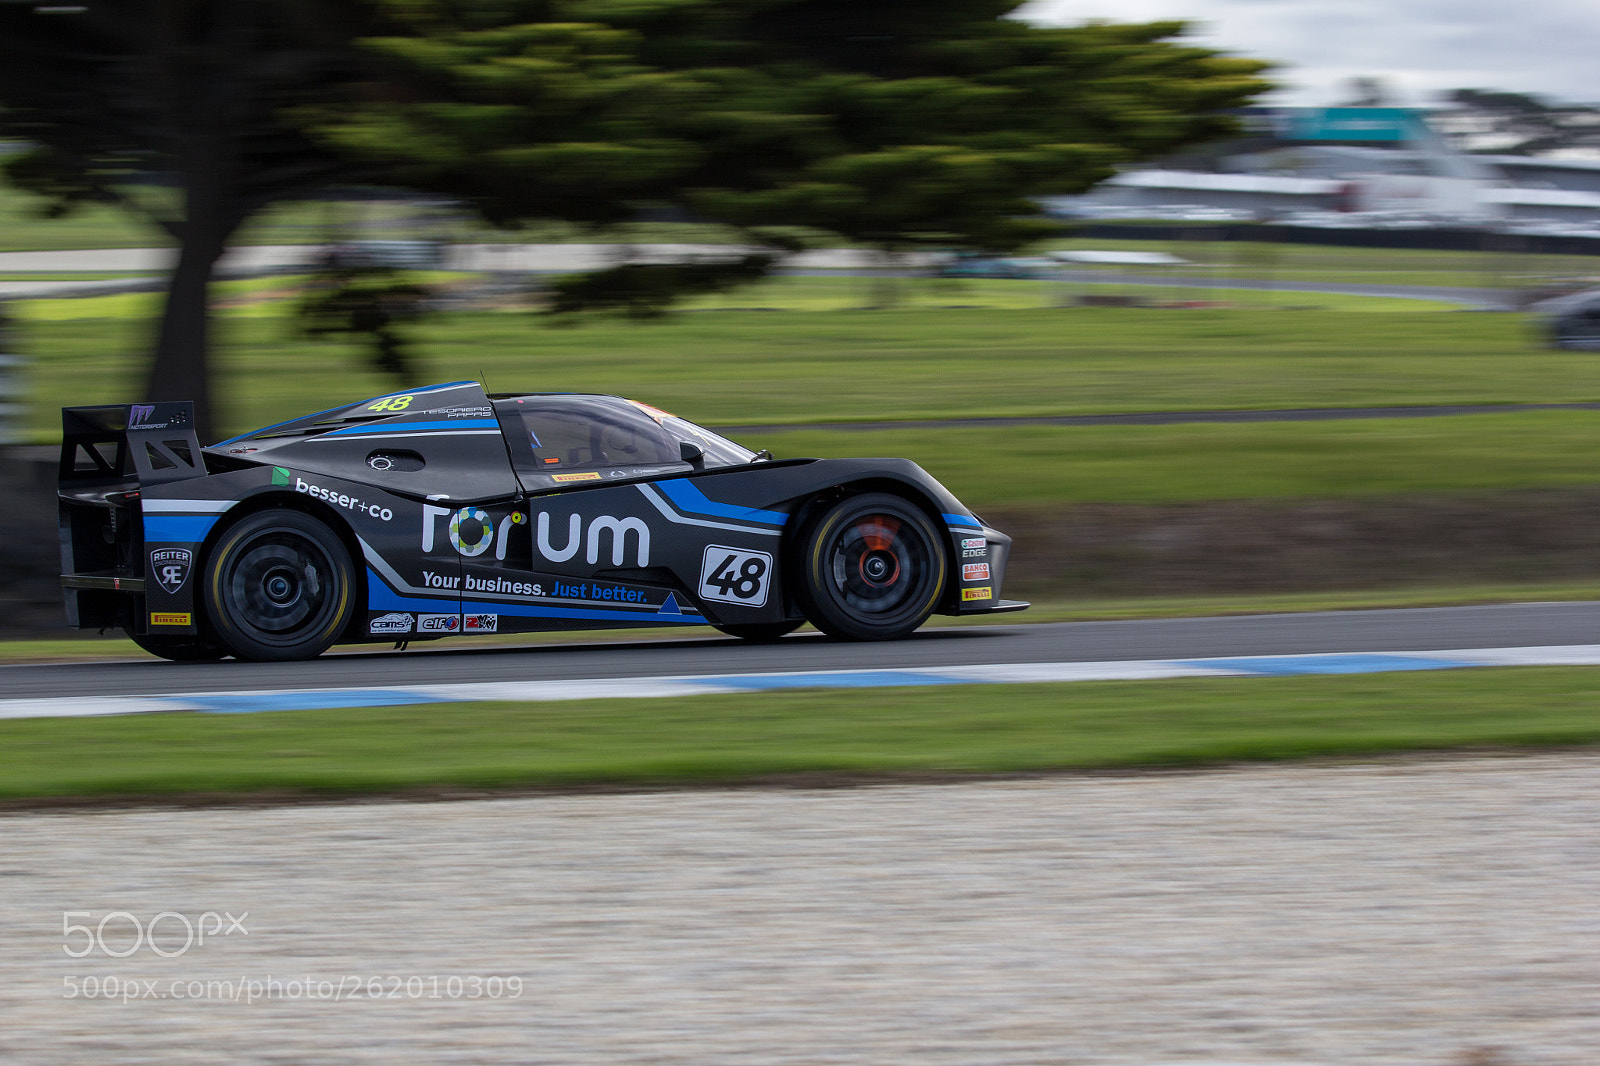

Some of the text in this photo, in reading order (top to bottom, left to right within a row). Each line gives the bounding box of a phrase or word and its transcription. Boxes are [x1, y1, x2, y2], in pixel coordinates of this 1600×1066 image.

[367, 395, 414, 412] 48
[295, 478, 393, 521] besser+co
[154, 551, 189, 561] REITER
[962, 549, 987, 558] EDGE
[706, 554, 766, 599] 48
[422, 571, 647, 603] Your business. Just better.
[422, 617, 447, 630] elf
